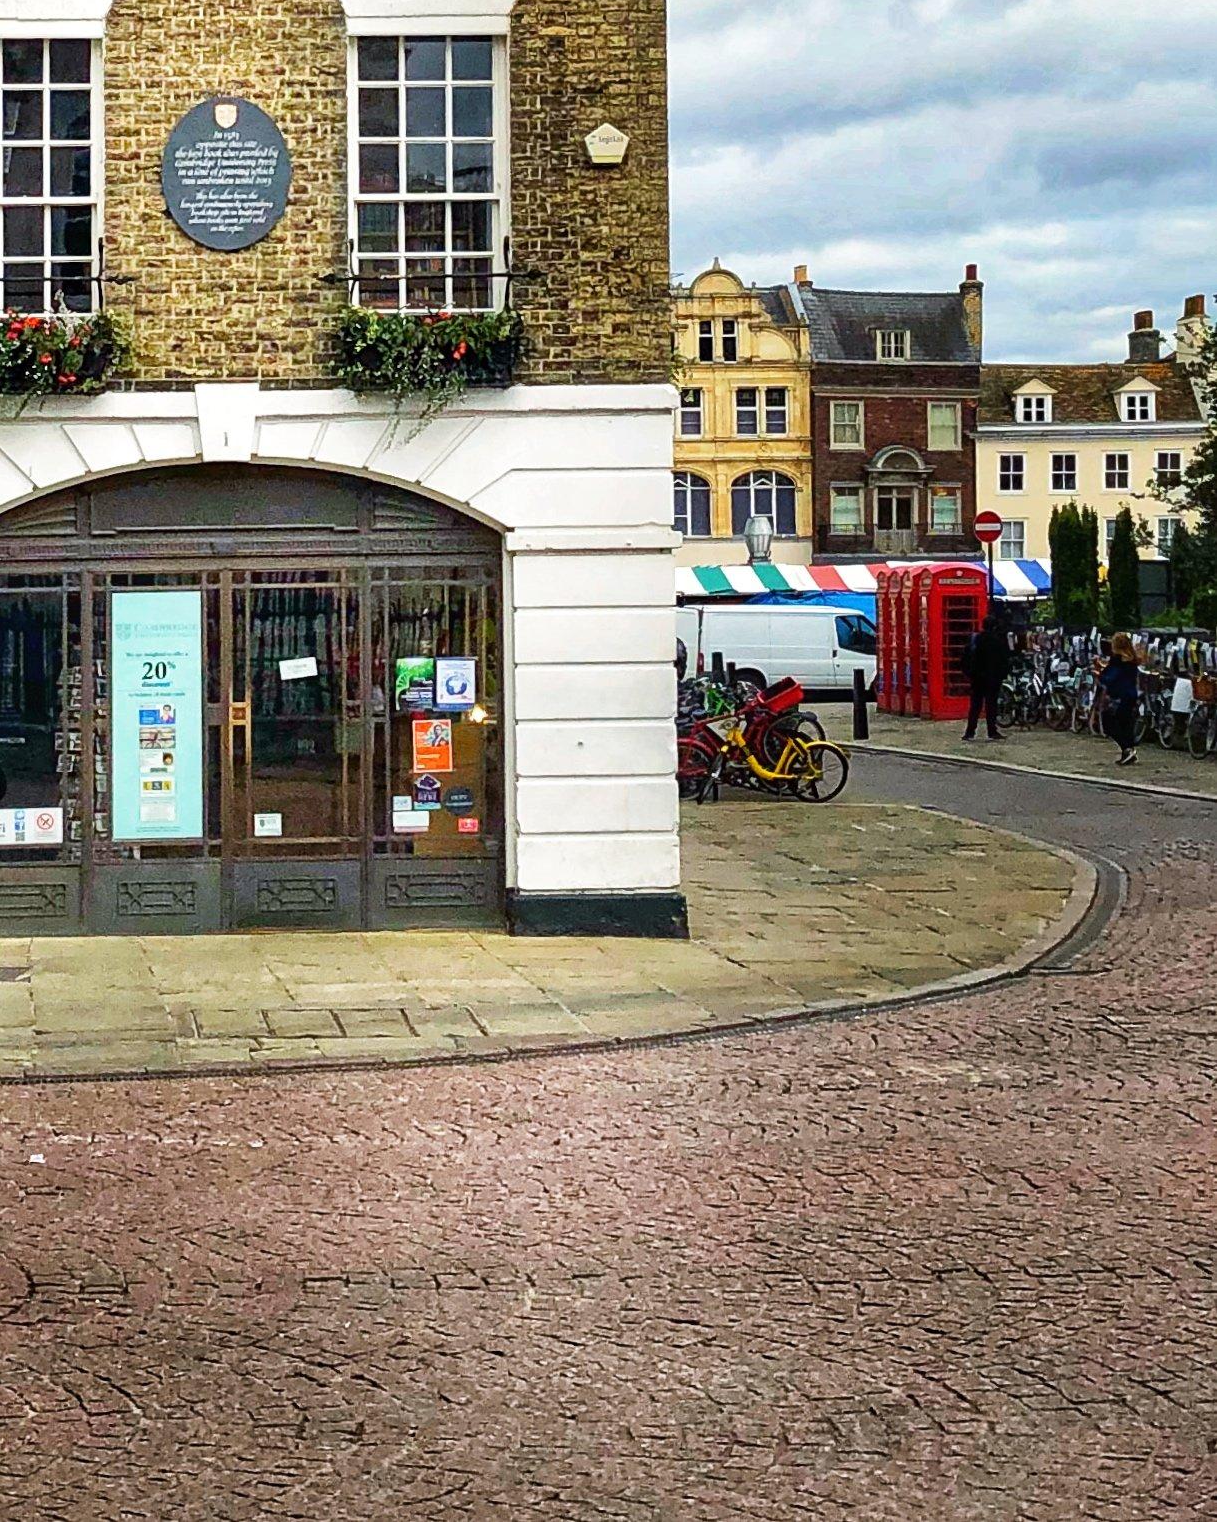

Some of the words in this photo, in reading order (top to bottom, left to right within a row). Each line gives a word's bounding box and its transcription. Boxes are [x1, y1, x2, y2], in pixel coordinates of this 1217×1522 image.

[195, 141, 227, 150] opposite
[204, 149, 222, 157] book
[268, 146, 279, 158] by
[175, 158, 215, 167] Cambridge
[217, 158, 256, 167] University
[258, 158, 276, 166] Press
[219, 168, 250, 177] printing
[197, 177, 234, 185] unbroken
